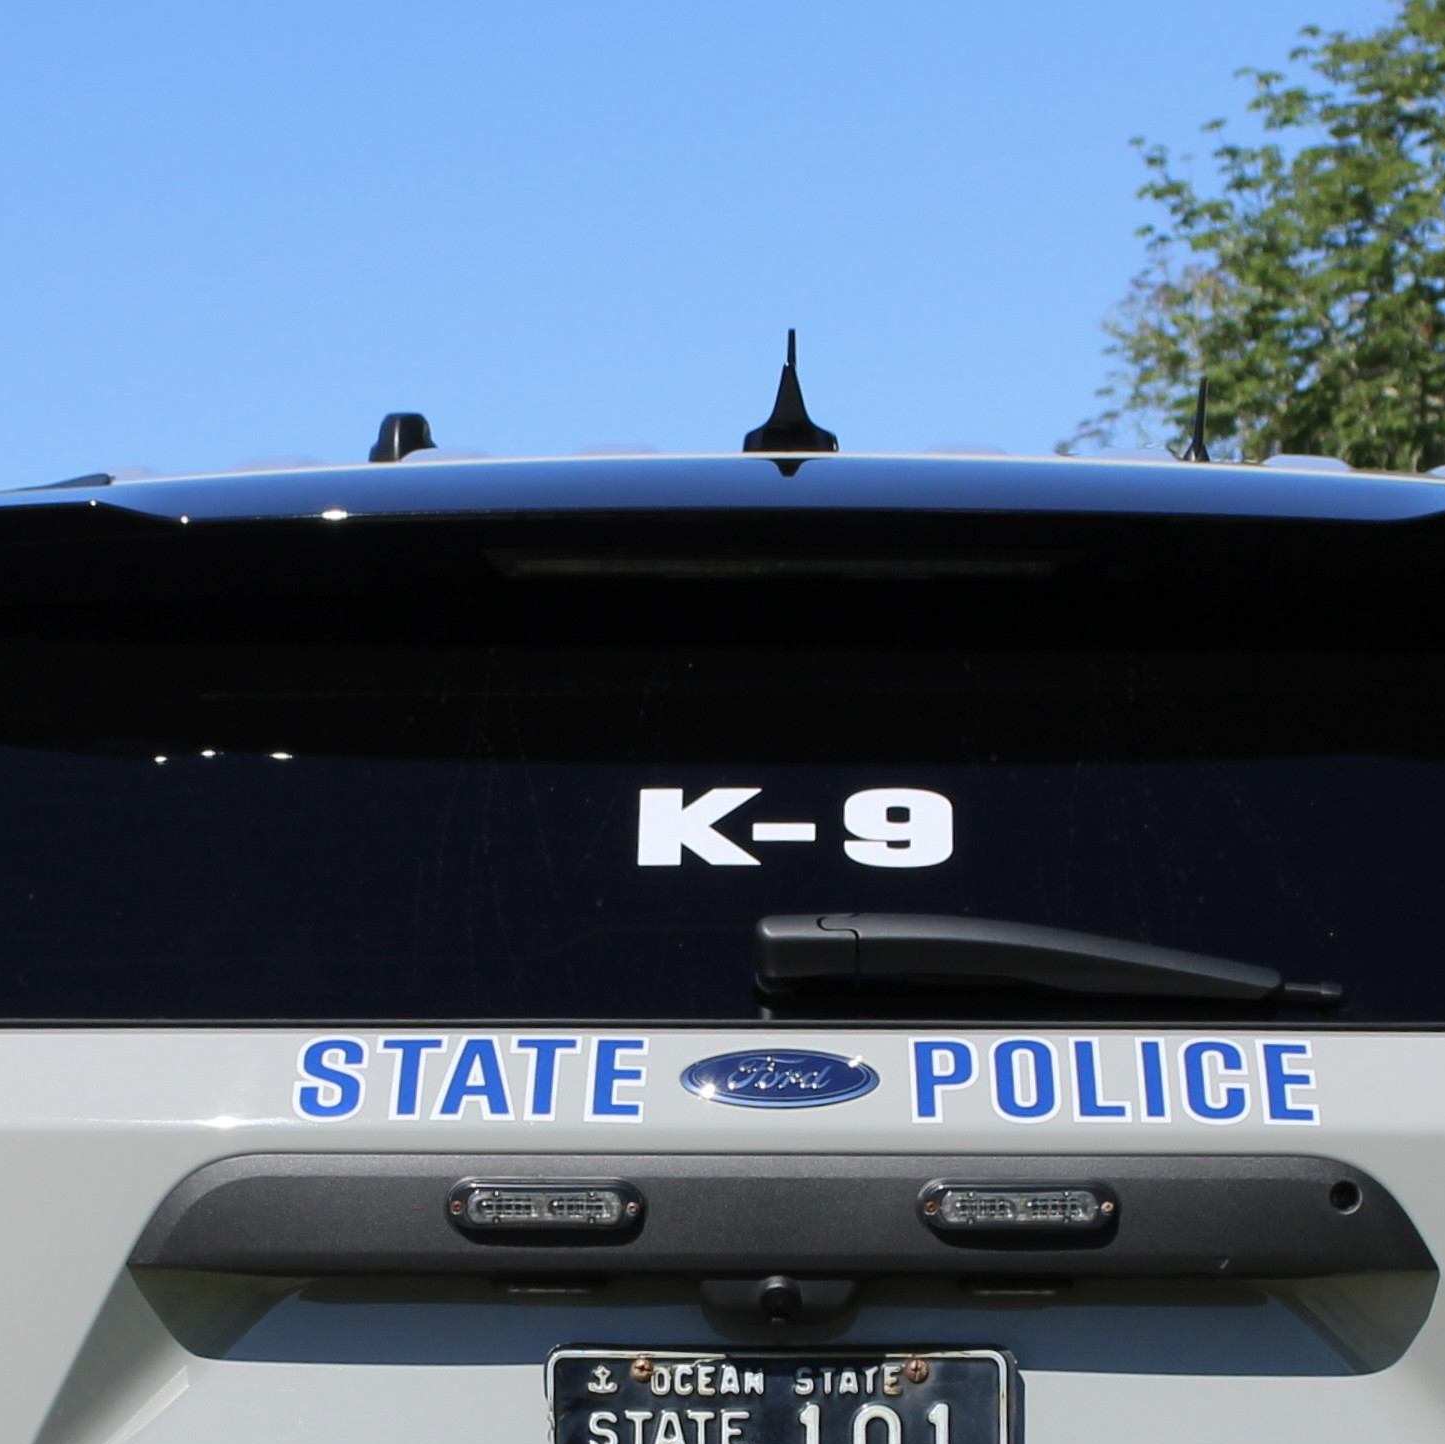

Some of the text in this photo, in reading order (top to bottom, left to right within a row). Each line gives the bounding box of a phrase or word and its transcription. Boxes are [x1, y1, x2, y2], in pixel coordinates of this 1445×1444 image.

[637, 788, 953, 868] K-9
[292, 1034, 1321, 1126] STATE POLICE
[727, 1055, 832, 1091] Ford
[650, 1363, 903, 1396] OCEAN STATE
